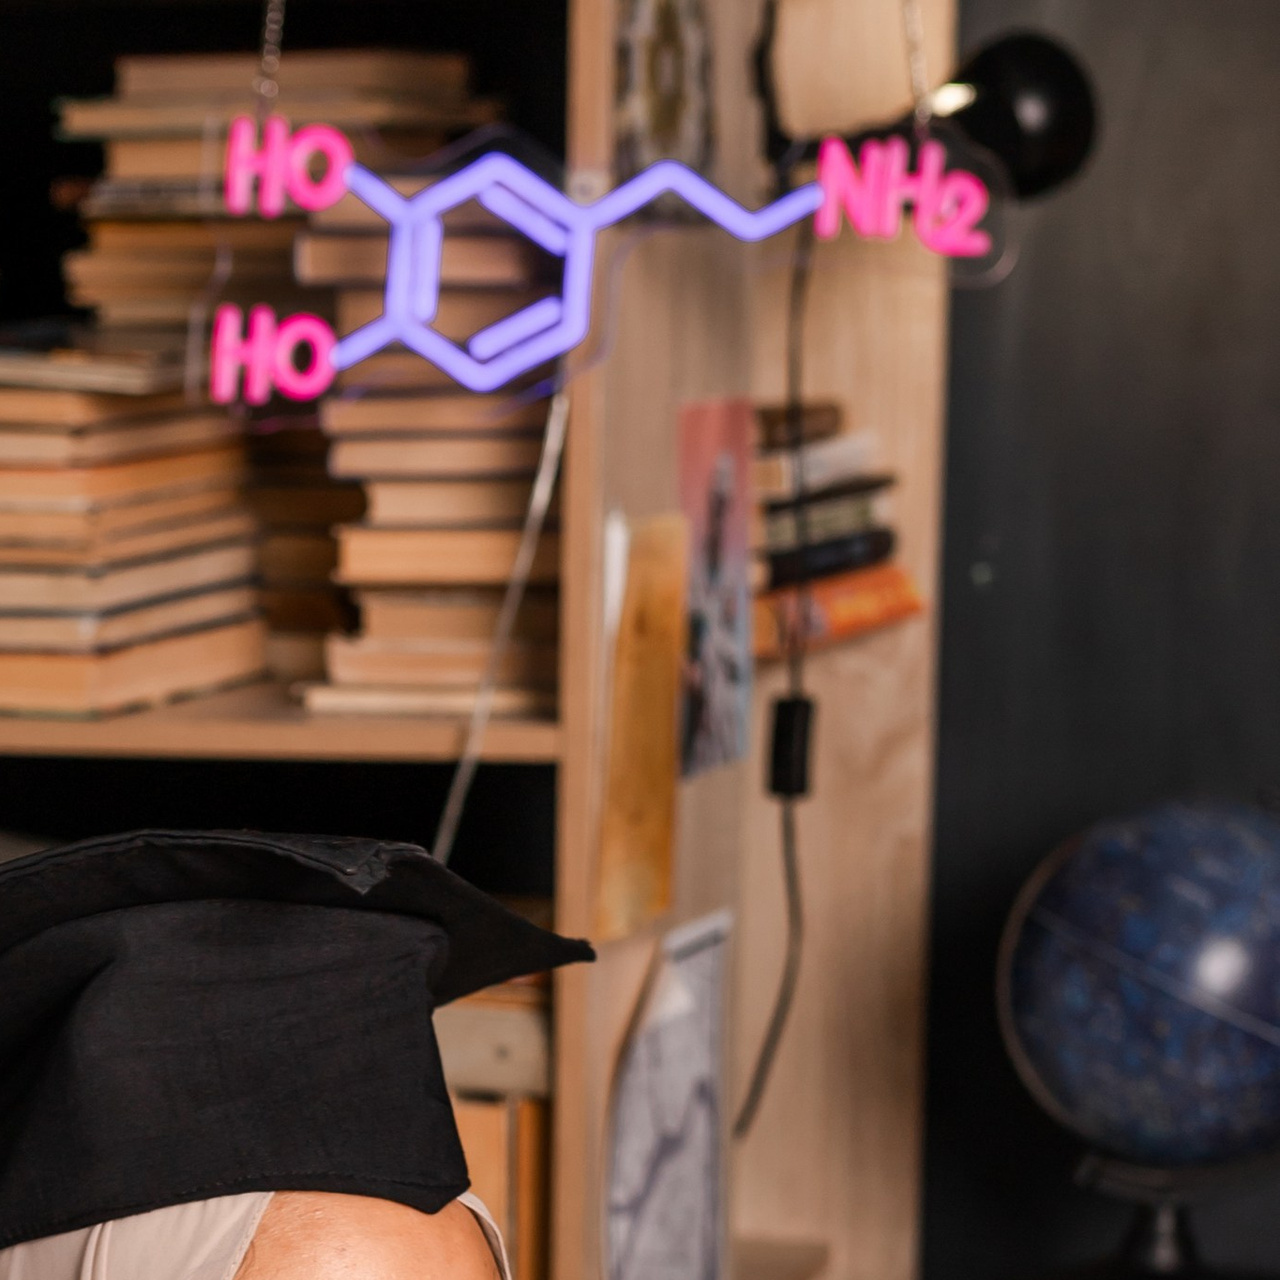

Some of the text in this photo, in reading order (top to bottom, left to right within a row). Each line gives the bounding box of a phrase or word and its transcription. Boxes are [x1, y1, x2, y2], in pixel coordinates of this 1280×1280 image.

[225, 115, 354, 217] HO
[815, 135, 993, 258] NH2
[210, 303, 340, 405] HO
